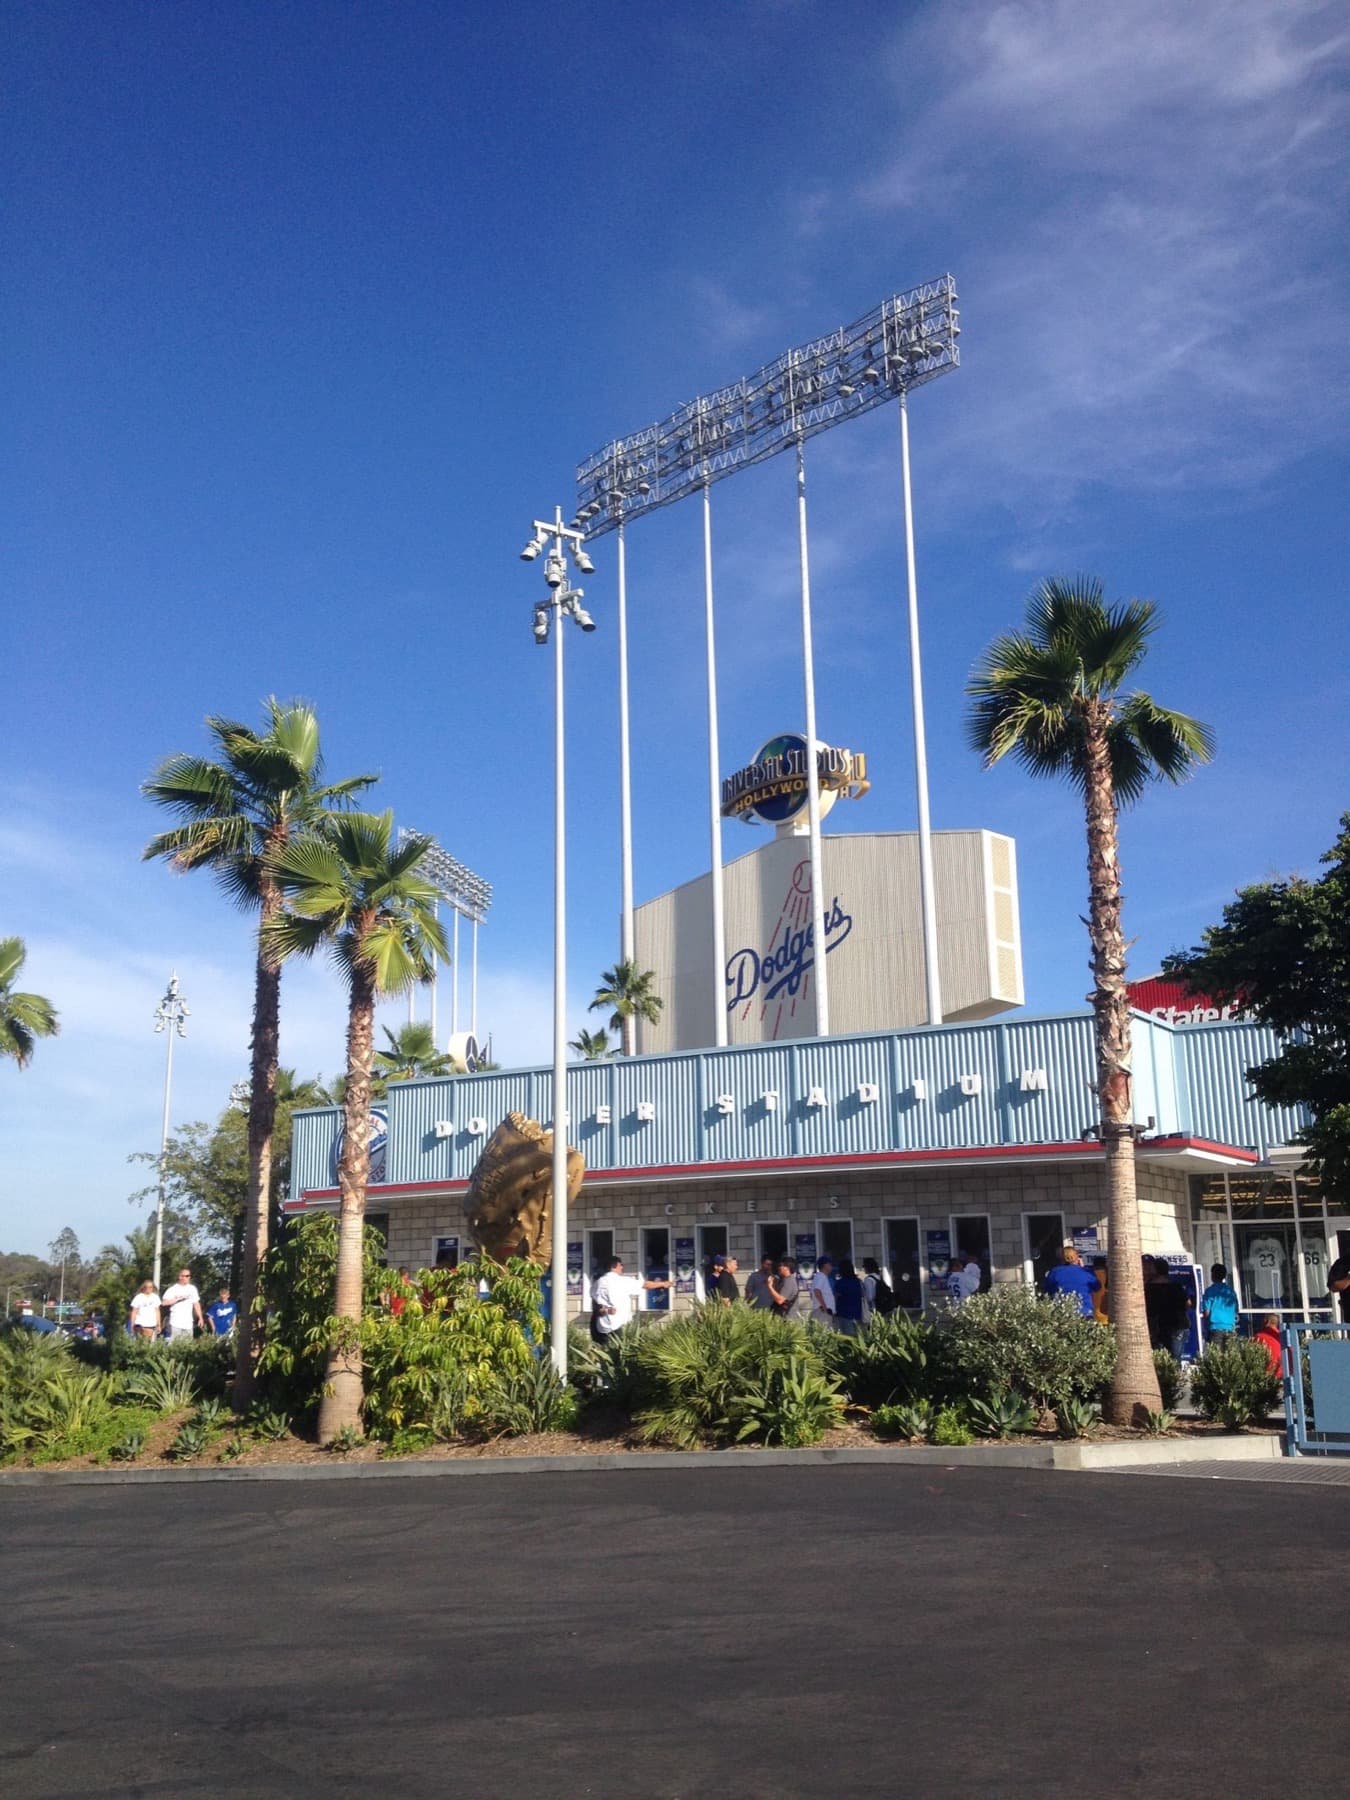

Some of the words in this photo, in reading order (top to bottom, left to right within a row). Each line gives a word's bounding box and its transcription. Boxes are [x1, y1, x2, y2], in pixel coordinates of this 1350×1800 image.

[735, 778, 830, 813] HOLLYWOD
[435, 1101, 655, 1139] DOER
[717, 1068, 1049, 1115] STADIUM
[591, 1196, 840, 1219] TICKETS
[1259, 1253, 1276, 1268] 23
[1304, 1251, 1320, 1265] 66
